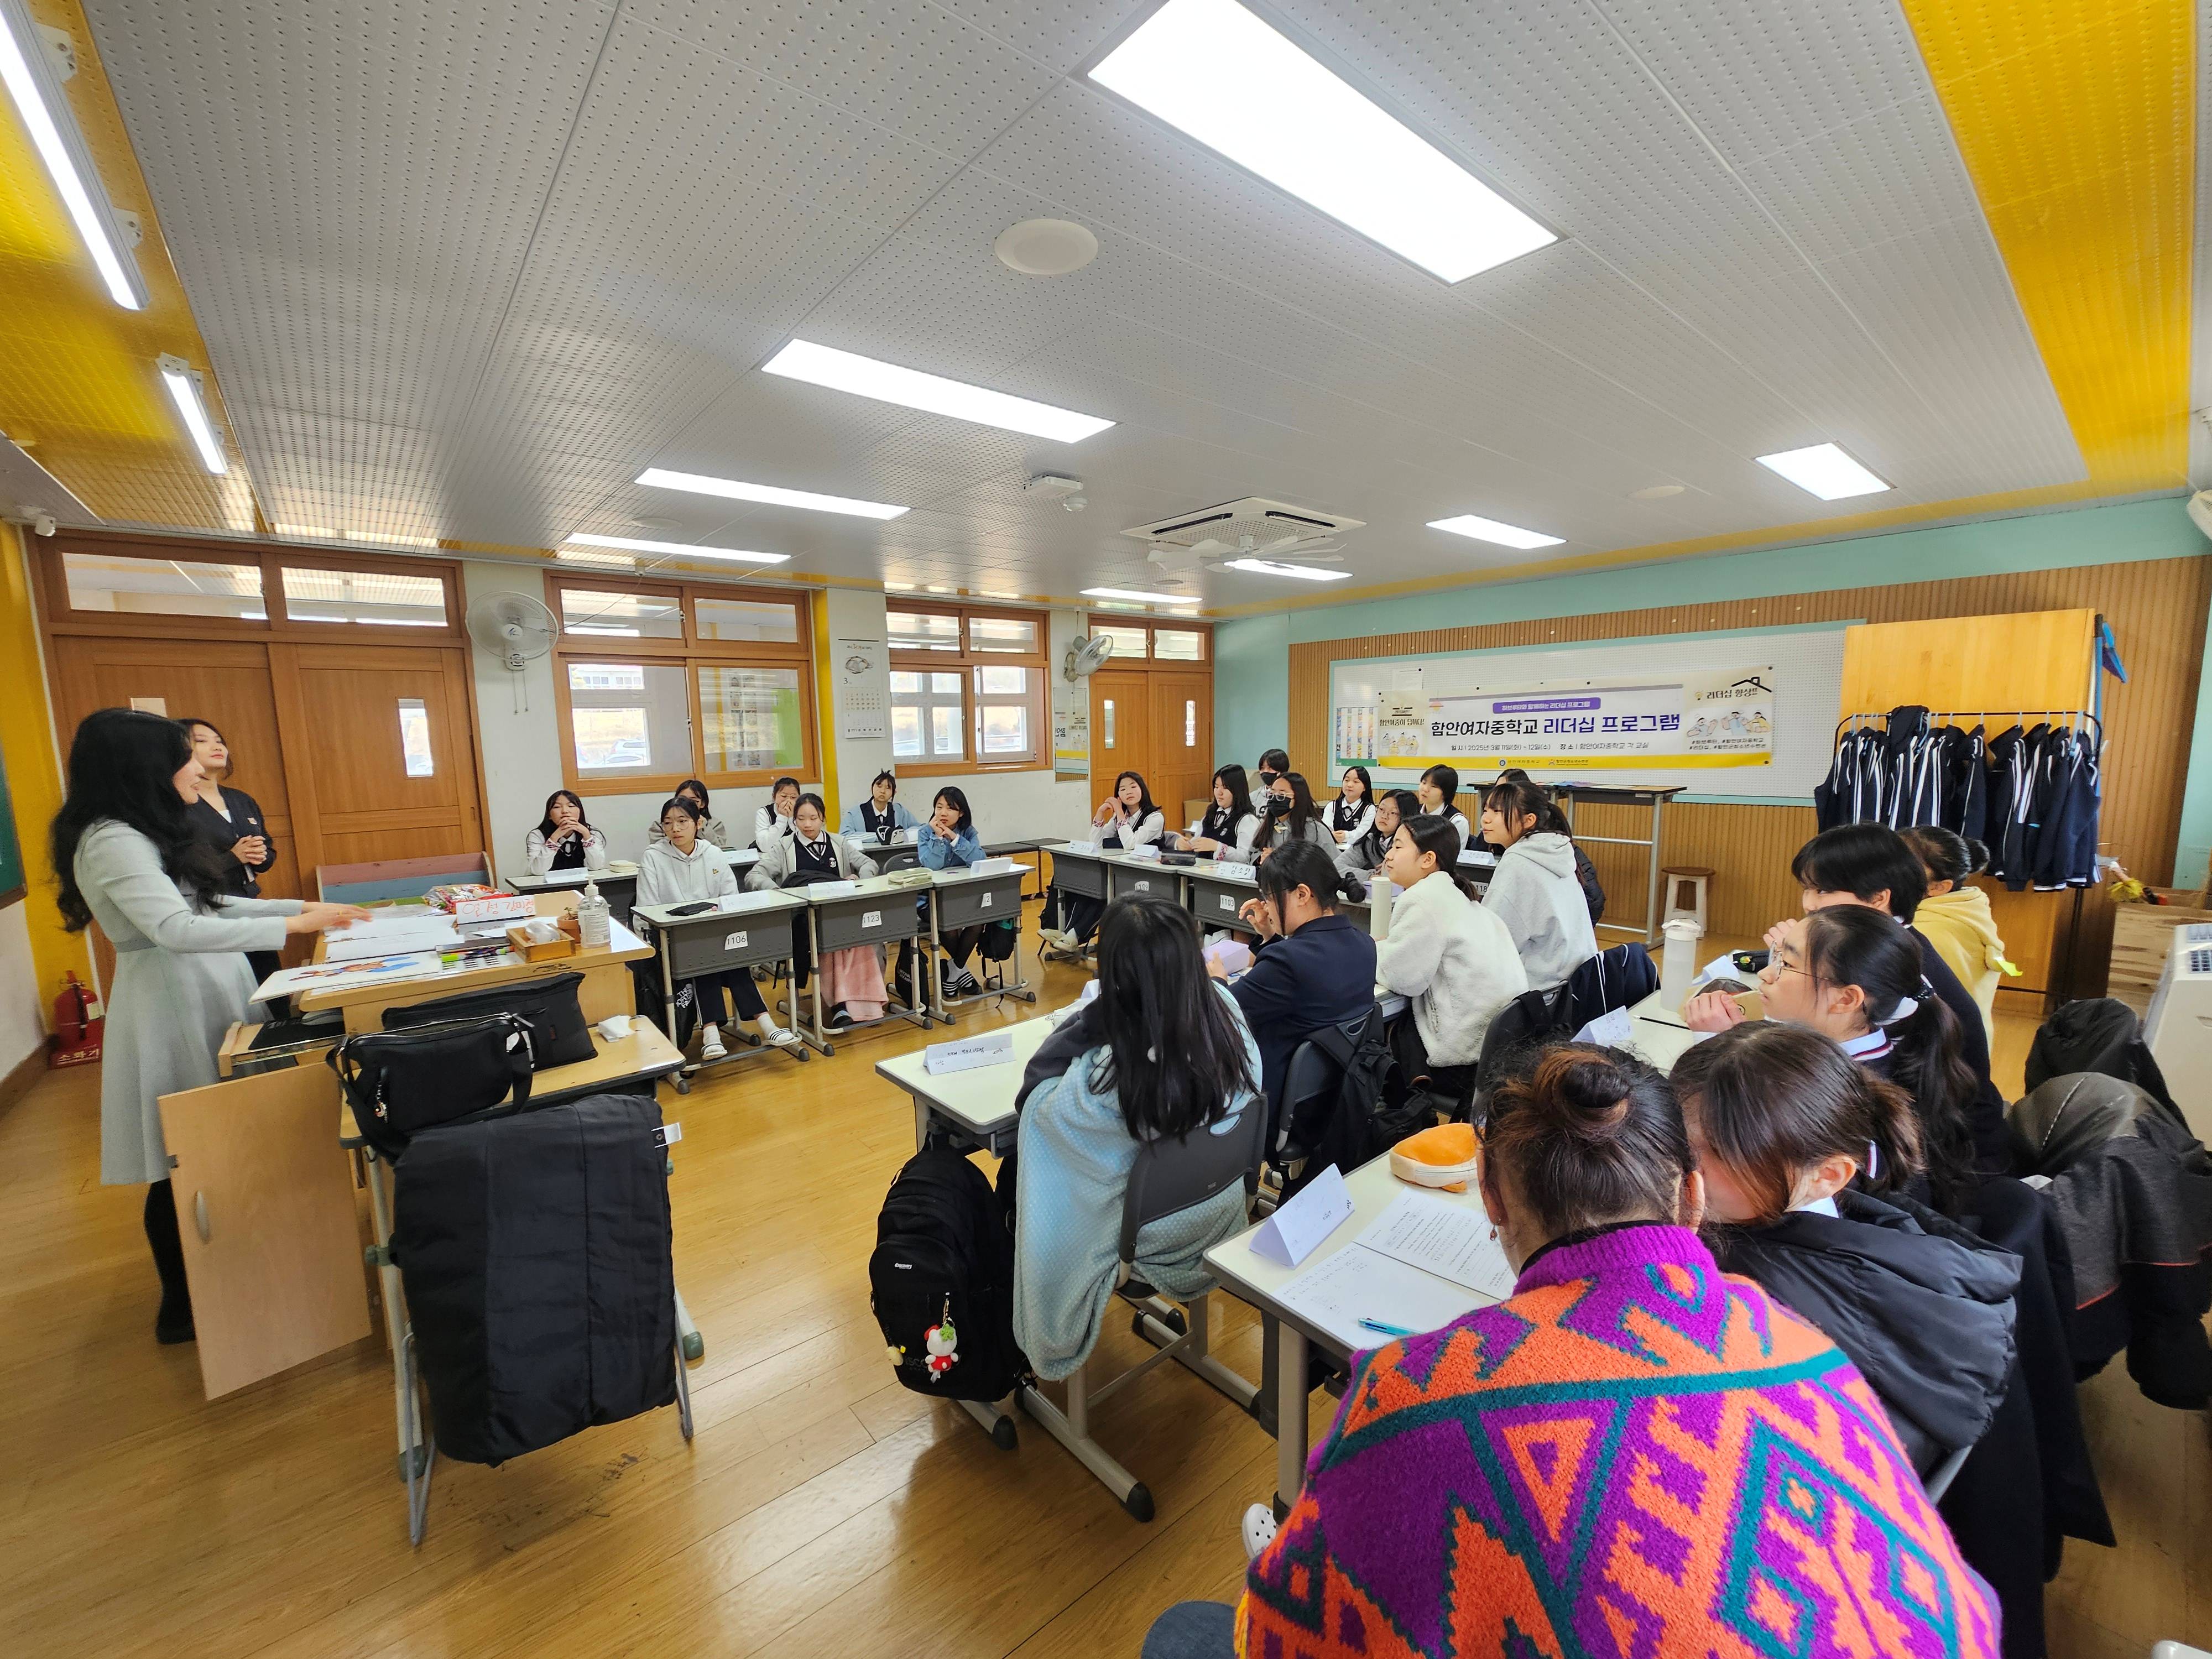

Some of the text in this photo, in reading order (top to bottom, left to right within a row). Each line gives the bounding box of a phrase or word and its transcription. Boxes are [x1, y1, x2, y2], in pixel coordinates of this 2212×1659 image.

[1707, 690, 1732, 699] 리더십
[1431, 714, 1680, 736] 함안여자중학교 리더십 프로그램
[1222, 898, 1234, 907] 1103
[863, 915, 880, 923] 1123
[727, 935, 746, 945] 1106
[57, 1048, 99, 1062] 소화기
